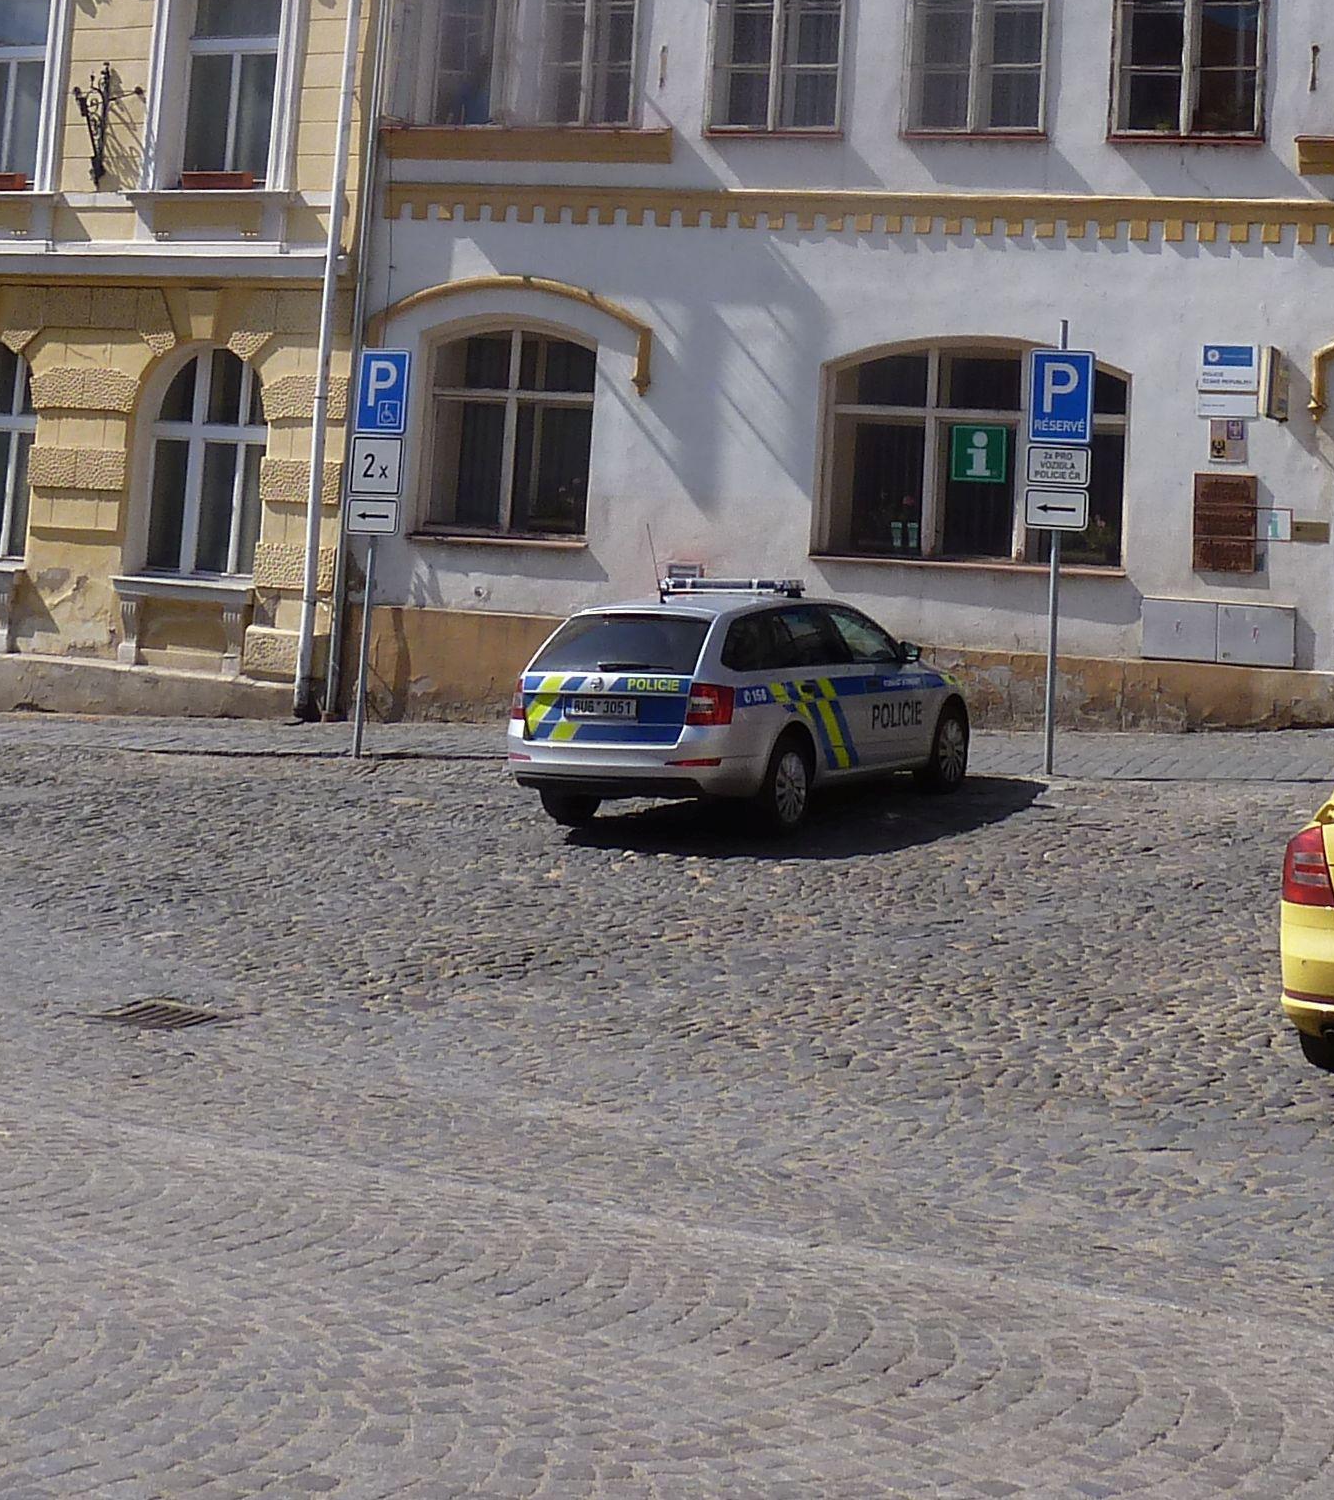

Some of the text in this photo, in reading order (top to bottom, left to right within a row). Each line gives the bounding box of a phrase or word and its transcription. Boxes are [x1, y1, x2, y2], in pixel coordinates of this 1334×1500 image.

[367, 360, 398, 407] P
[1043, 362, 1079, 413] P
[1034, 418, 1085, 433] RÉSERVÉ
[1034, 470, 1067, 479] POLICIE
[627, 677, 680, 691] POLICIE
[872, 701, 923, 730] POLICIE
